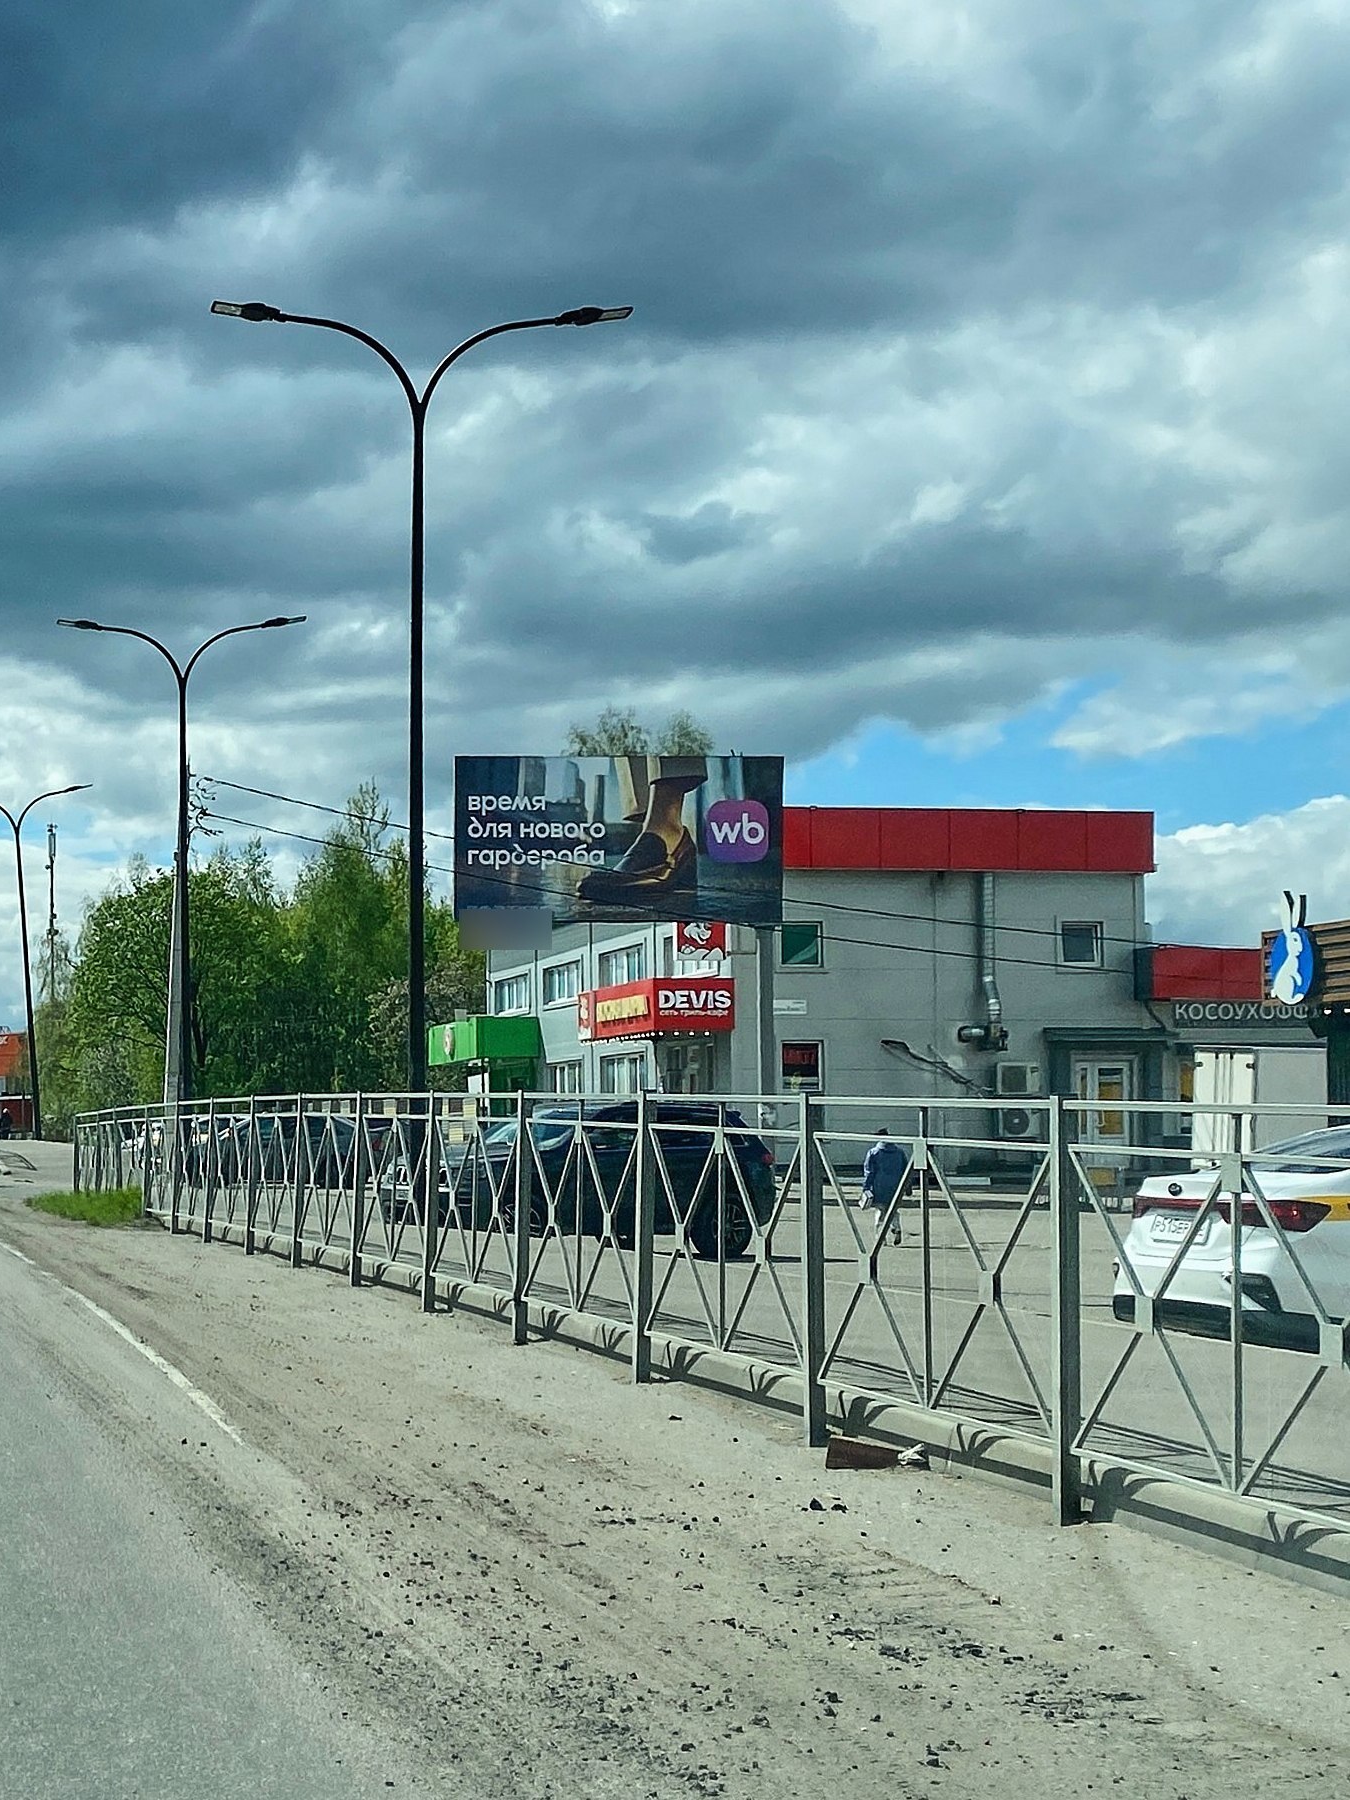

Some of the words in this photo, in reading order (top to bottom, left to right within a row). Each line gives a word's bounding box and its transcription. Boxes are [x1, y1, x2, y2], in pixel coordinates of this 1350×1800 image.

[468, 795, 546, 816] время
[467, 817, 512, 838] для
[519, 822, 606, 838] нового
[710, 812, 765, 845] wb
[467, 844, 605, 870] гардероба
[658, 990, 732, 1010] DEVIS
